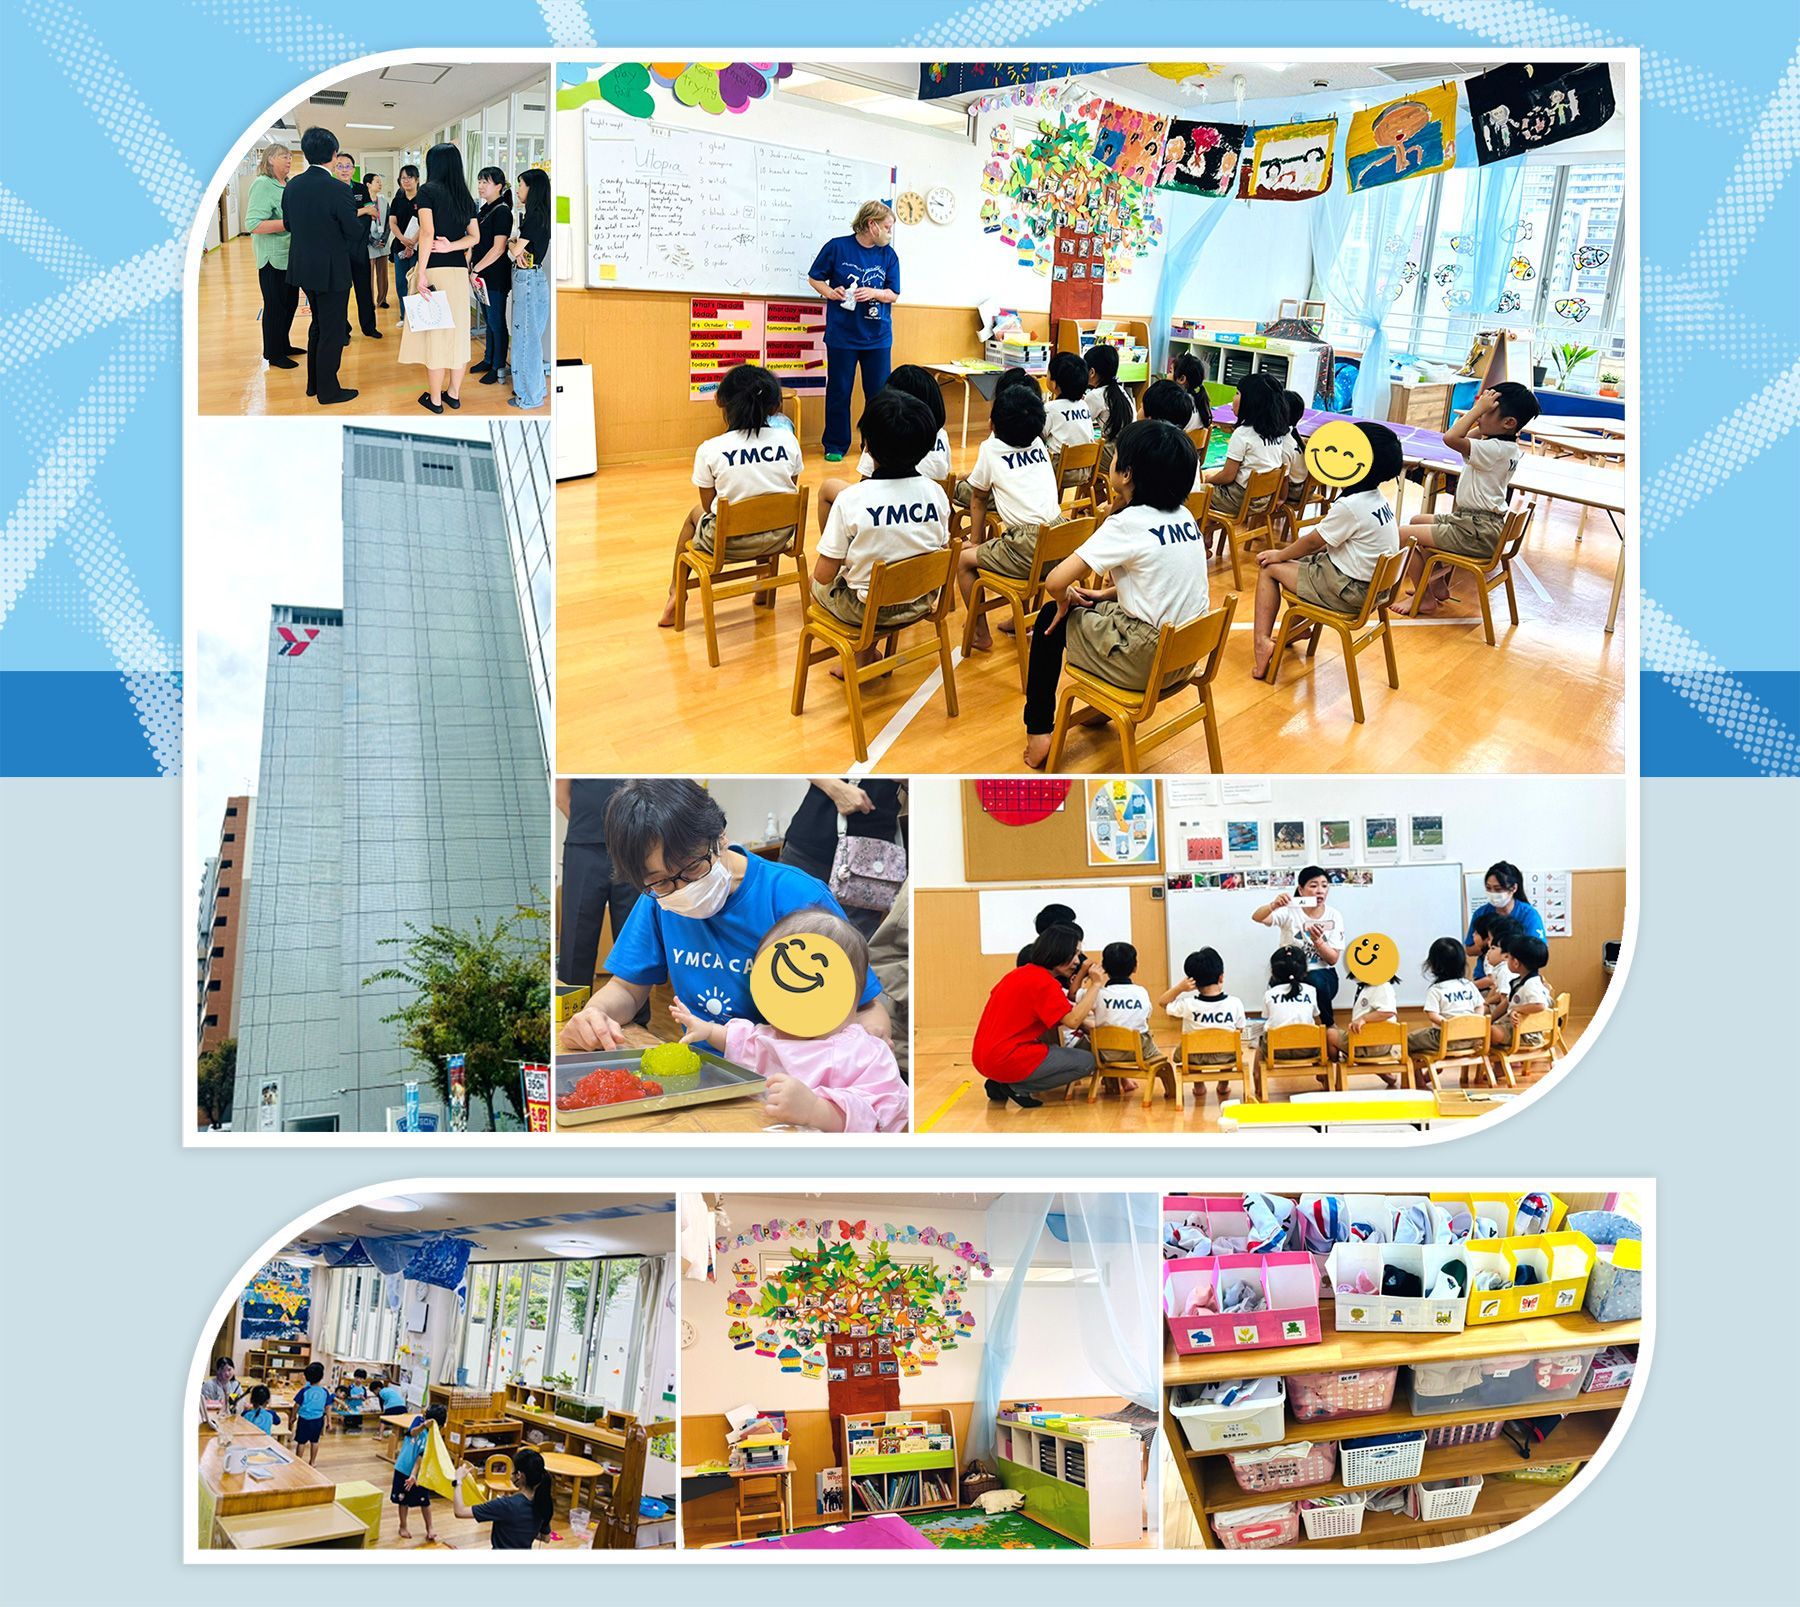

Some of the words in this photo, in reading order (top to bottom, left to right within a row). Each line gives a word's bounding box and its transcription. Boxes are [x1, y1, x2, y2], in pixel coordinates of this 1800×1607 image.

[683, 74, 718, 100] trying
[634, 145, 682, 176] Utopia
[1061, 409, 1091, 422] YMCA
[722, 445, 789, 467] YMCA
[1001, 448, 1048, 470] YMCA
[866, 502, 939, 527] YMCA
[672, 948, 724, 970] YMCA
[1103, 998, 1142, 1010] YMCA
[1271, 993, 1312, 1004] YMCA
[1444, 990, 1473, 1003] YMCA
[1192, 1011, 1234, 1023] YMCA
